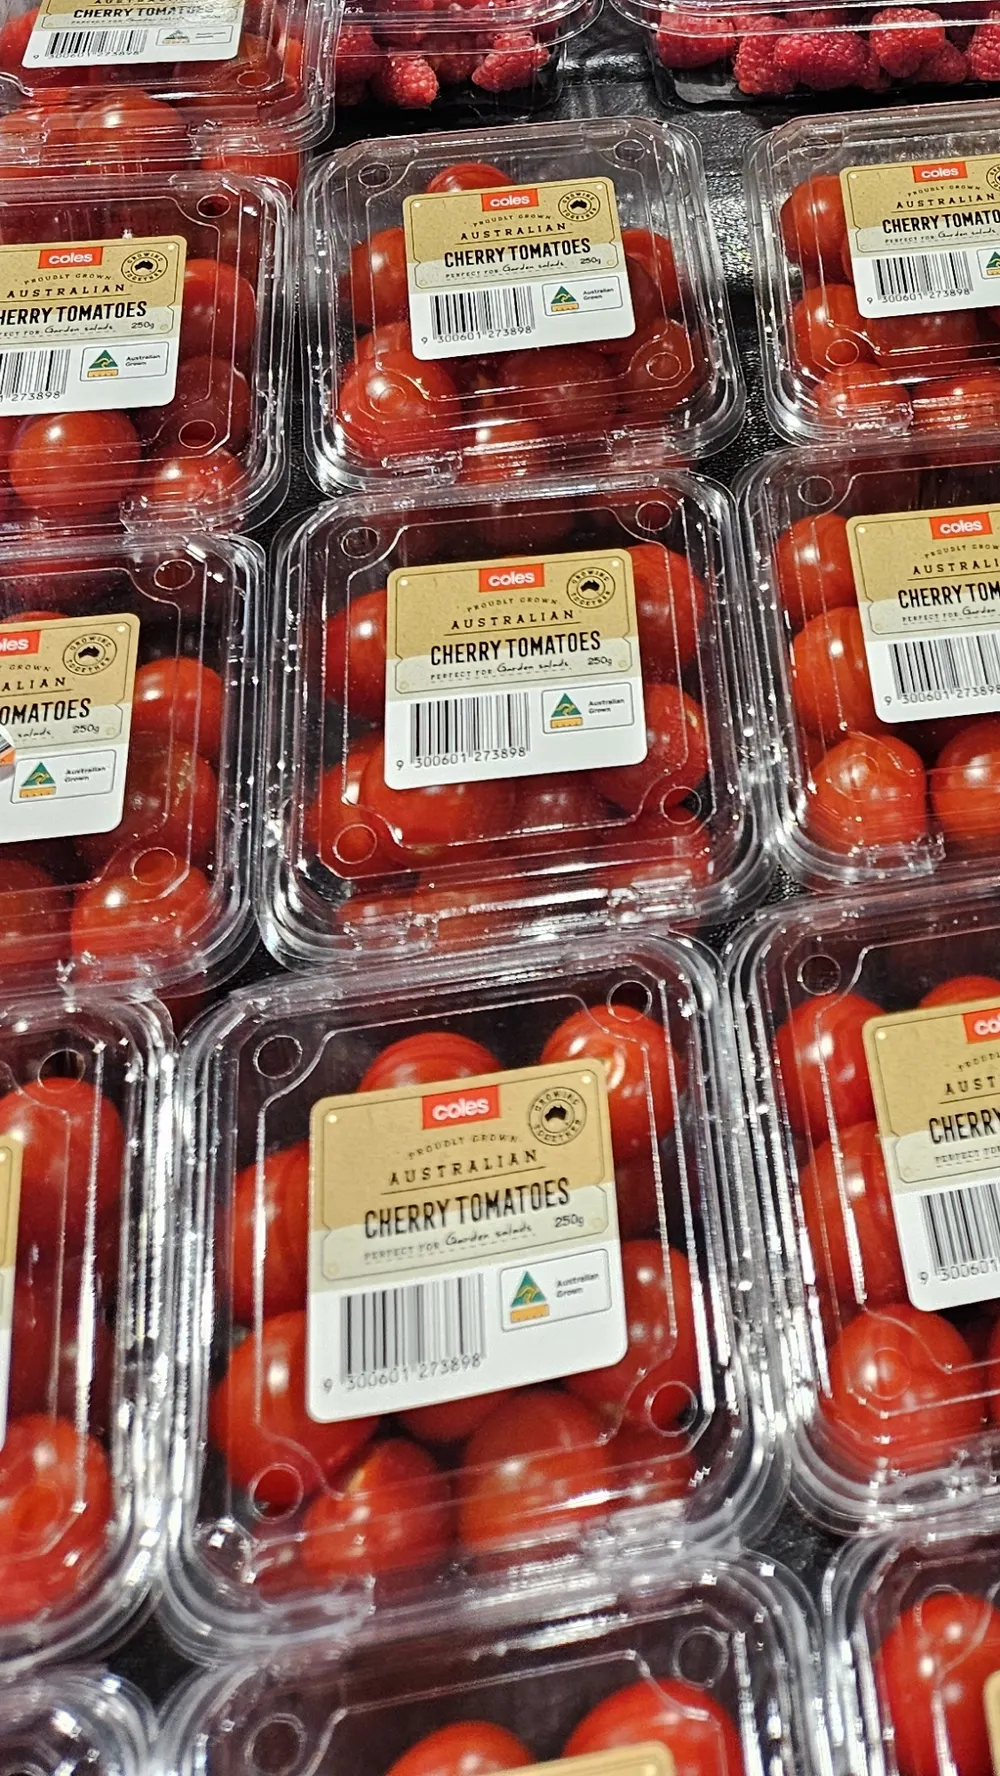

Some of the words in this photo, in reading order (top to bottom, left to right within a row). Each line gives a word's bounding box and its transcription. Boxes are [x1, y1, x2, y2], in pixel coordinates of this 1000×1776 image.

[73, 8, 134, 20] CHERRY
[920, 166, 960, 179] coles
[488, 194, 531, 207] coles
[895, 191, 995, 209] AUSTRALIAN
[459, 221, 566, 241] AUSTRALIAN
[881, 214, 939, 234] CHERRY
[47, 251, 94, 265] coles
[443, 245, 505, 268] CHERRY
[506, 236, 591, 261] TOMATOES
[5, 282, 125, 299] AUSTRALIAN
[865, 296, 874, 305] 9
[55, 299, 147, 322] TOMATOES
[420, 336, 429, 346] 9
[938, 518, 983, 534] coles
[487, 570, 536, 587] coles
[896, 583, 962, 609] CHERRY
[450, 608, 574, 630] AUSTRALIAN
[430, 638, 502, 666] CHERRY
[503, 629, 601, 659] TOMATOES
[883, 694, 893, 706] 9
[0, 696, 92, 727] OMATOES
[395, 757, 404, 770] 9
[432, 1097, 490, 1121] coles
[388, 1147, 536, 1186] AUSTRALIAN
[363, 1196, 450, 1240] CHERRY
[453, 1175, 569, 1223] TOMATOES
